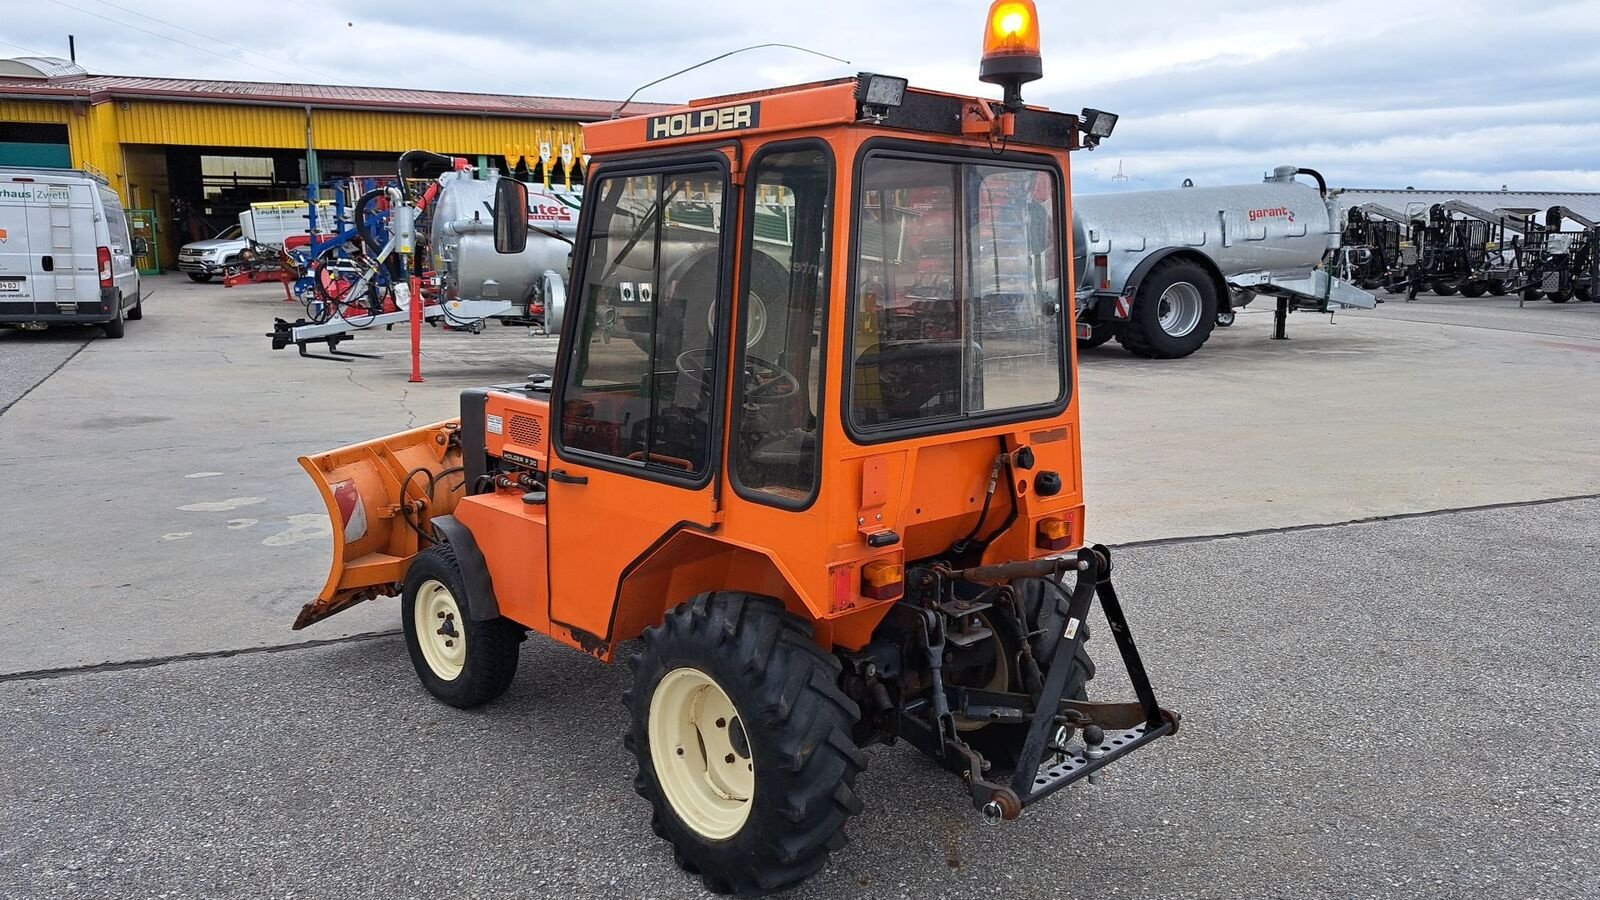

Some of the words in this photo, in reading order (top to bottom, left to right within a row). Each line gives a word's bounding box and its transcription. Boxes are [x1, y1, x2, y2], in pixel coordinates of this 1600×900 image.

[653, 104, 752, 139] HOLDER
[482, 200, 570, 217] Vutec
[1249, 206, 1288, 222] garant
